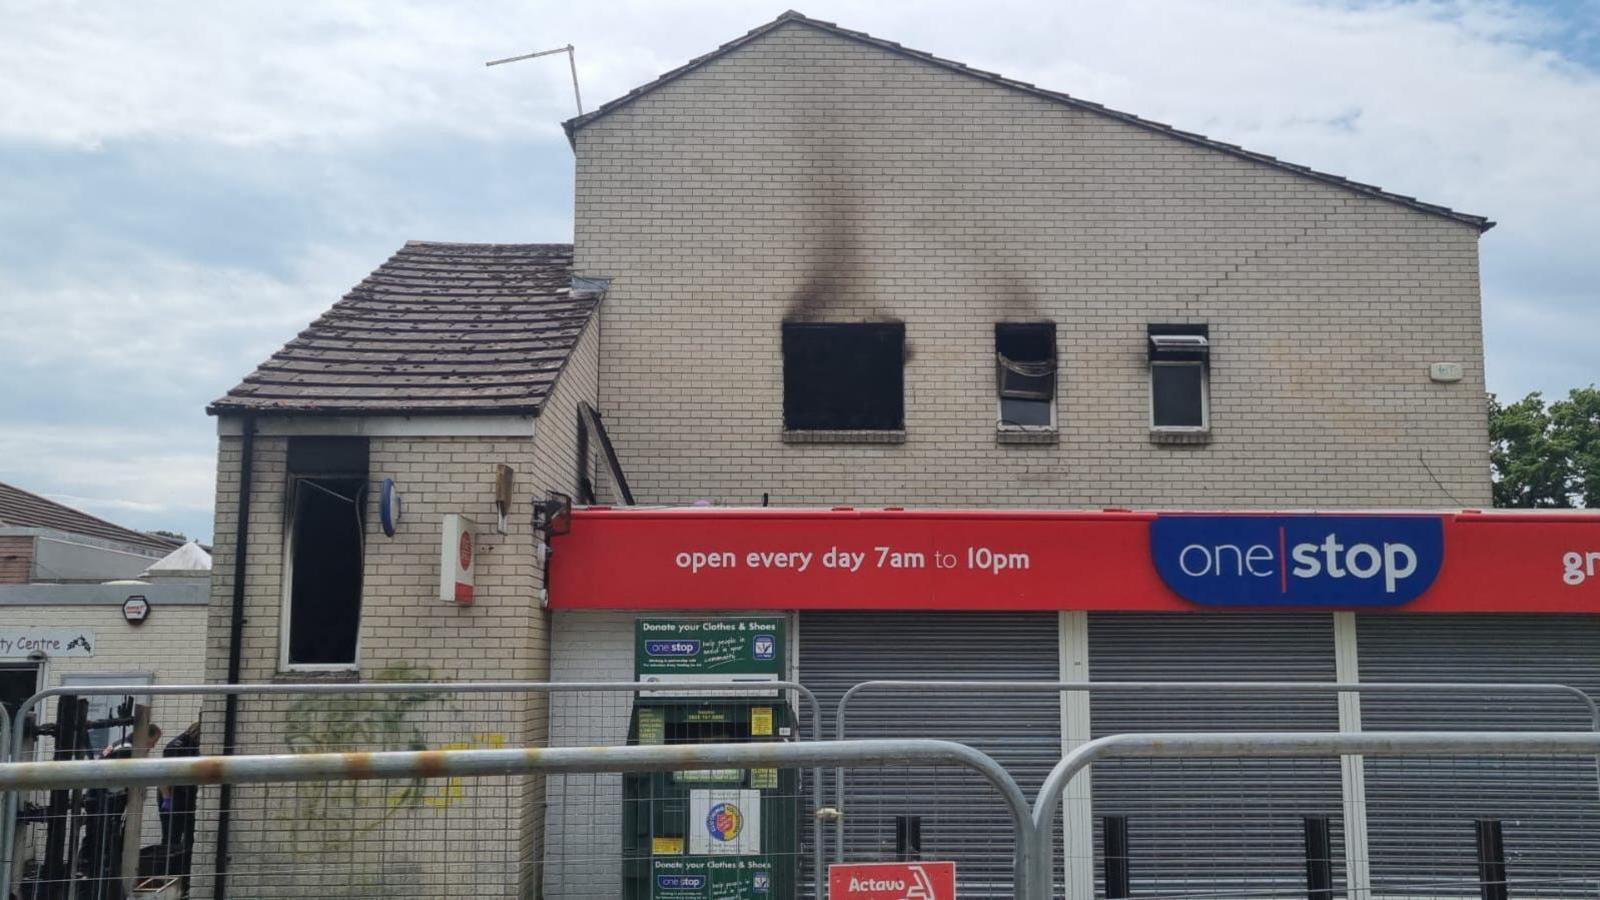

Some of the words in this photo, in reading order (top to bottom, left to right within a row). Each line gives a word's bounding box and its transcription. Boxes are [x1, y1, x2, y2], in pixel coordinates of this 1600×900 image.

[675, 551, 736, 573] open
[746, 551, 812, 572] every
[822, 547, 865, 572] day
[874, 547, 925, 569] 7am
[934, 550, 957, 569] to
[1179, 543, 1274, 577] one
[1291, 533, 1418, 593] stop
[643, 623, 676, 632] Donate
[678, 624, 700, 633] your
[703, 622, 736, 631] Clothes
[738, 622, 746, 631] &
[749, 622, 776, 631] Shoes
[17, 637, 60, 650] Centre
[652, 644, 670, 652] one
[671, 643, 694, 654] stop
[655, 861, 682, 869] Donate
[686, 862, 704, 870] your
[707, 861, 736, 869] Clothes
[738, 861, 745, 869] &
[748, 861, 771, 869] Shoes
[681, 878, 700, 887] stop
[848, 878, 905, 892] Actavo
